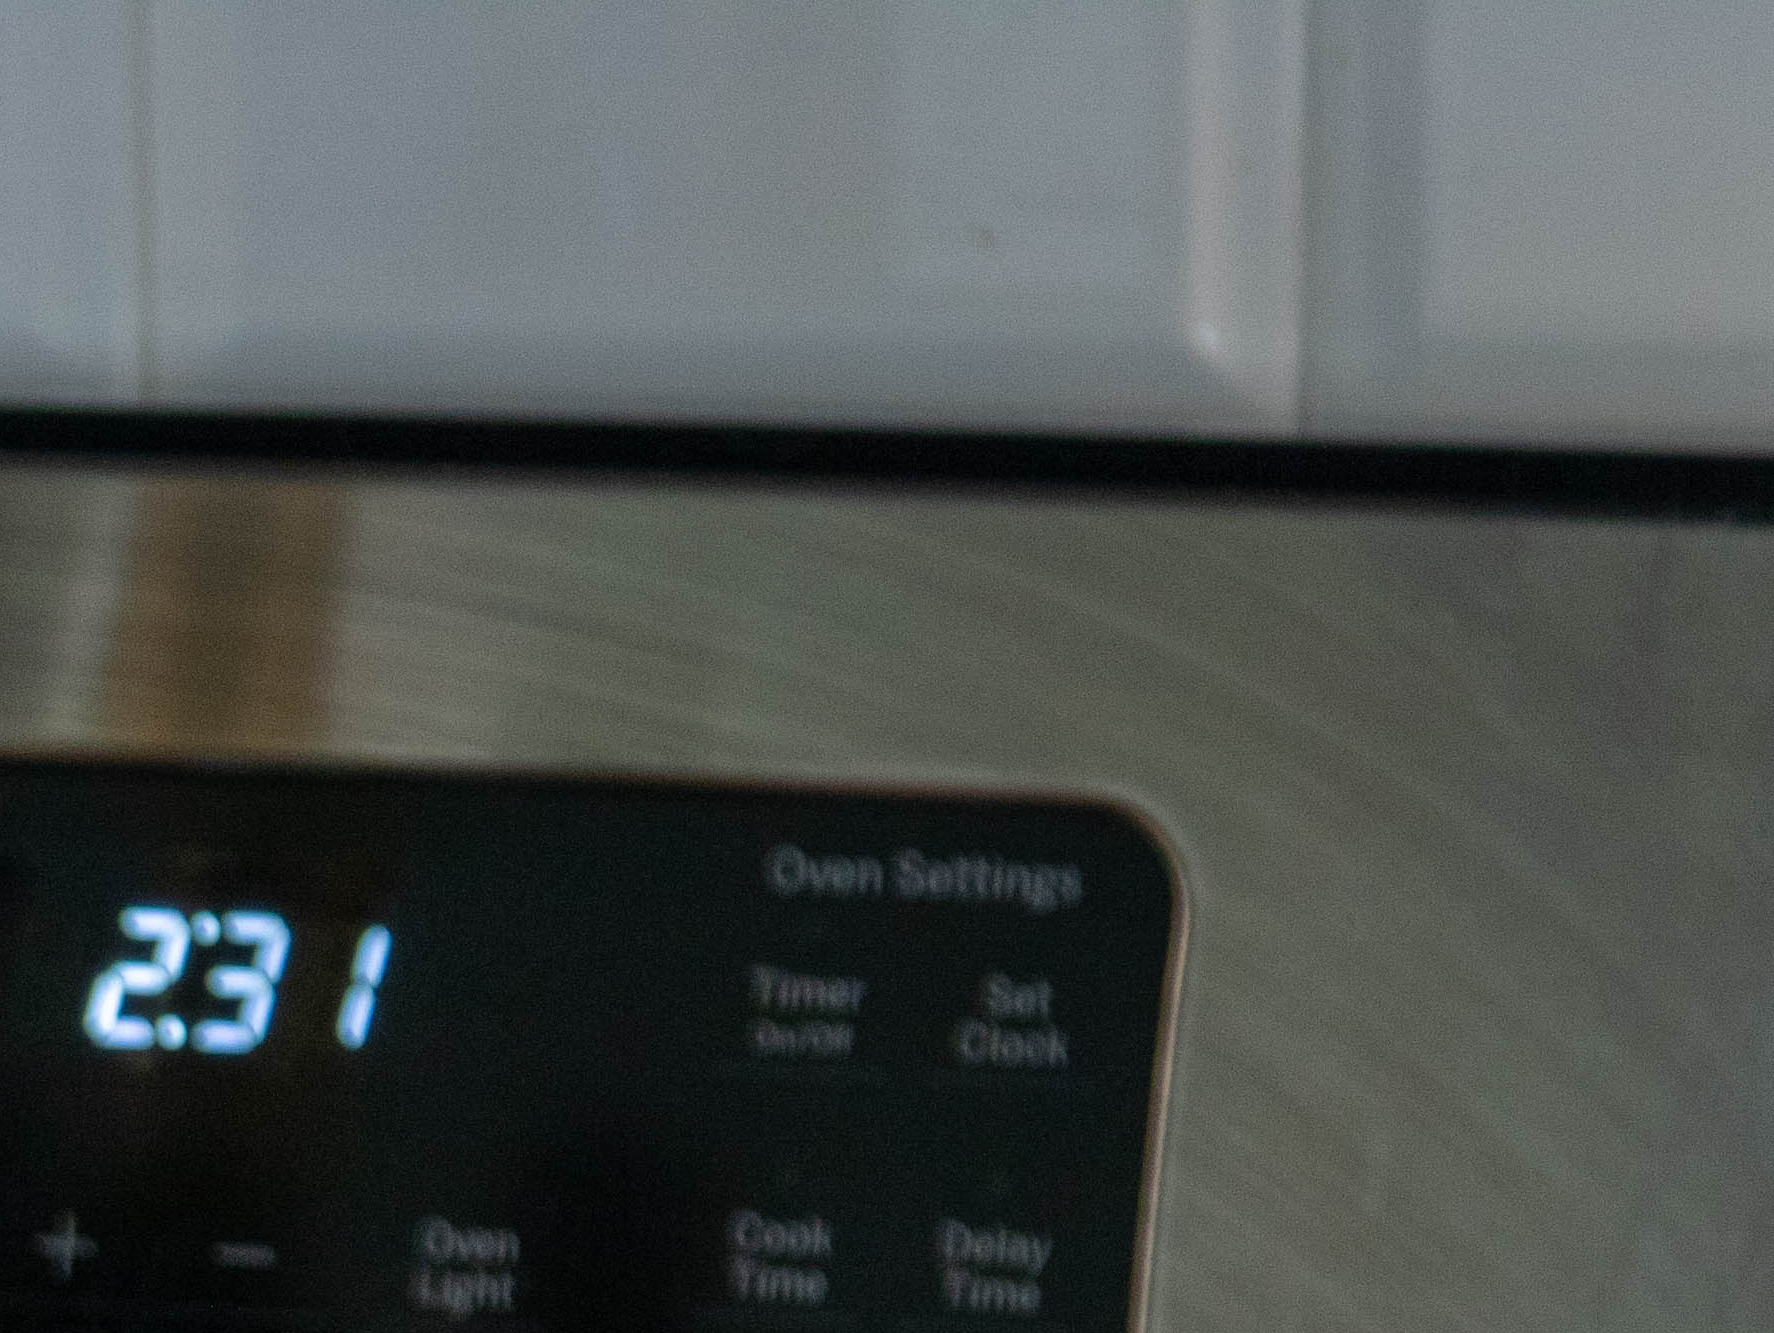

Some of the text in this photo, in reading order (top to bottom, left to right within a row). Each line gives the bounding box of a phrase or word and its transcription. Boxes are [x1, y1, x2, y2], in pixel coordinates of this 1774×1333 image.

[769, 844, 1084, 912] Oven Settings
[83, 905, 393, 1055] 2:31
[752, 965, 865, 1017] Timer
[986, 972, 1053, 1016] Set
[956, 1020, 1068, 1070] Clock
[418, 1214, 520, 1264] Oven
[728, 1210, 832, 1257] Cook
[940, 1218, 1053, 1276] Delay
[412, 1266, 514, 1320] Light
[730, 1258, 829, 1306] Time
[945, 1266, 1043, 1314] Time
